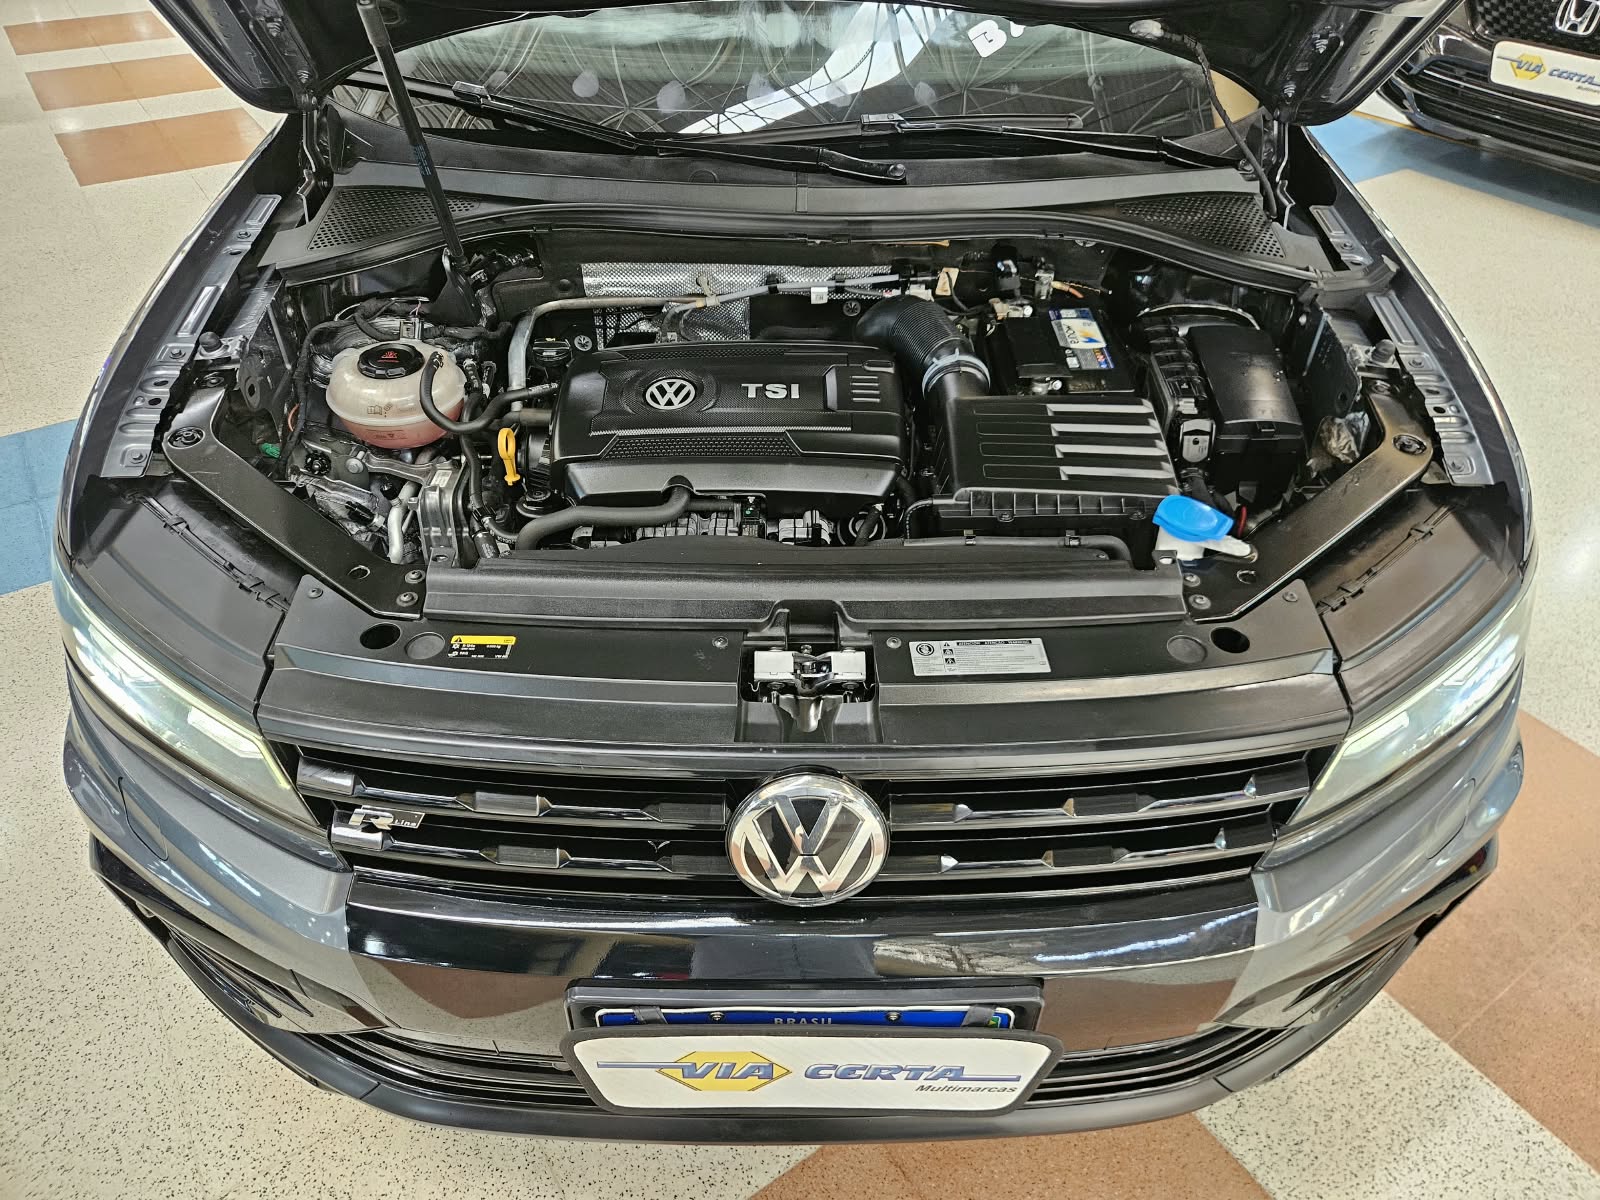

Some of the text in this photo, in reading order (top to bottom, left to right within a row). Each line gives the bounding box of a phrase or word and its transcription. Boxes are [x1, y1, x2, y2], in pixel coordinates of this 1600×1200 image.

[1516, 61, 1595, 84] VIA CERTA
[741, 383, 800, 399] TSI
[681, 1062, 965, 1082] VIA CERTA
[914, 1084, 1019, 1094] Multimarcas
